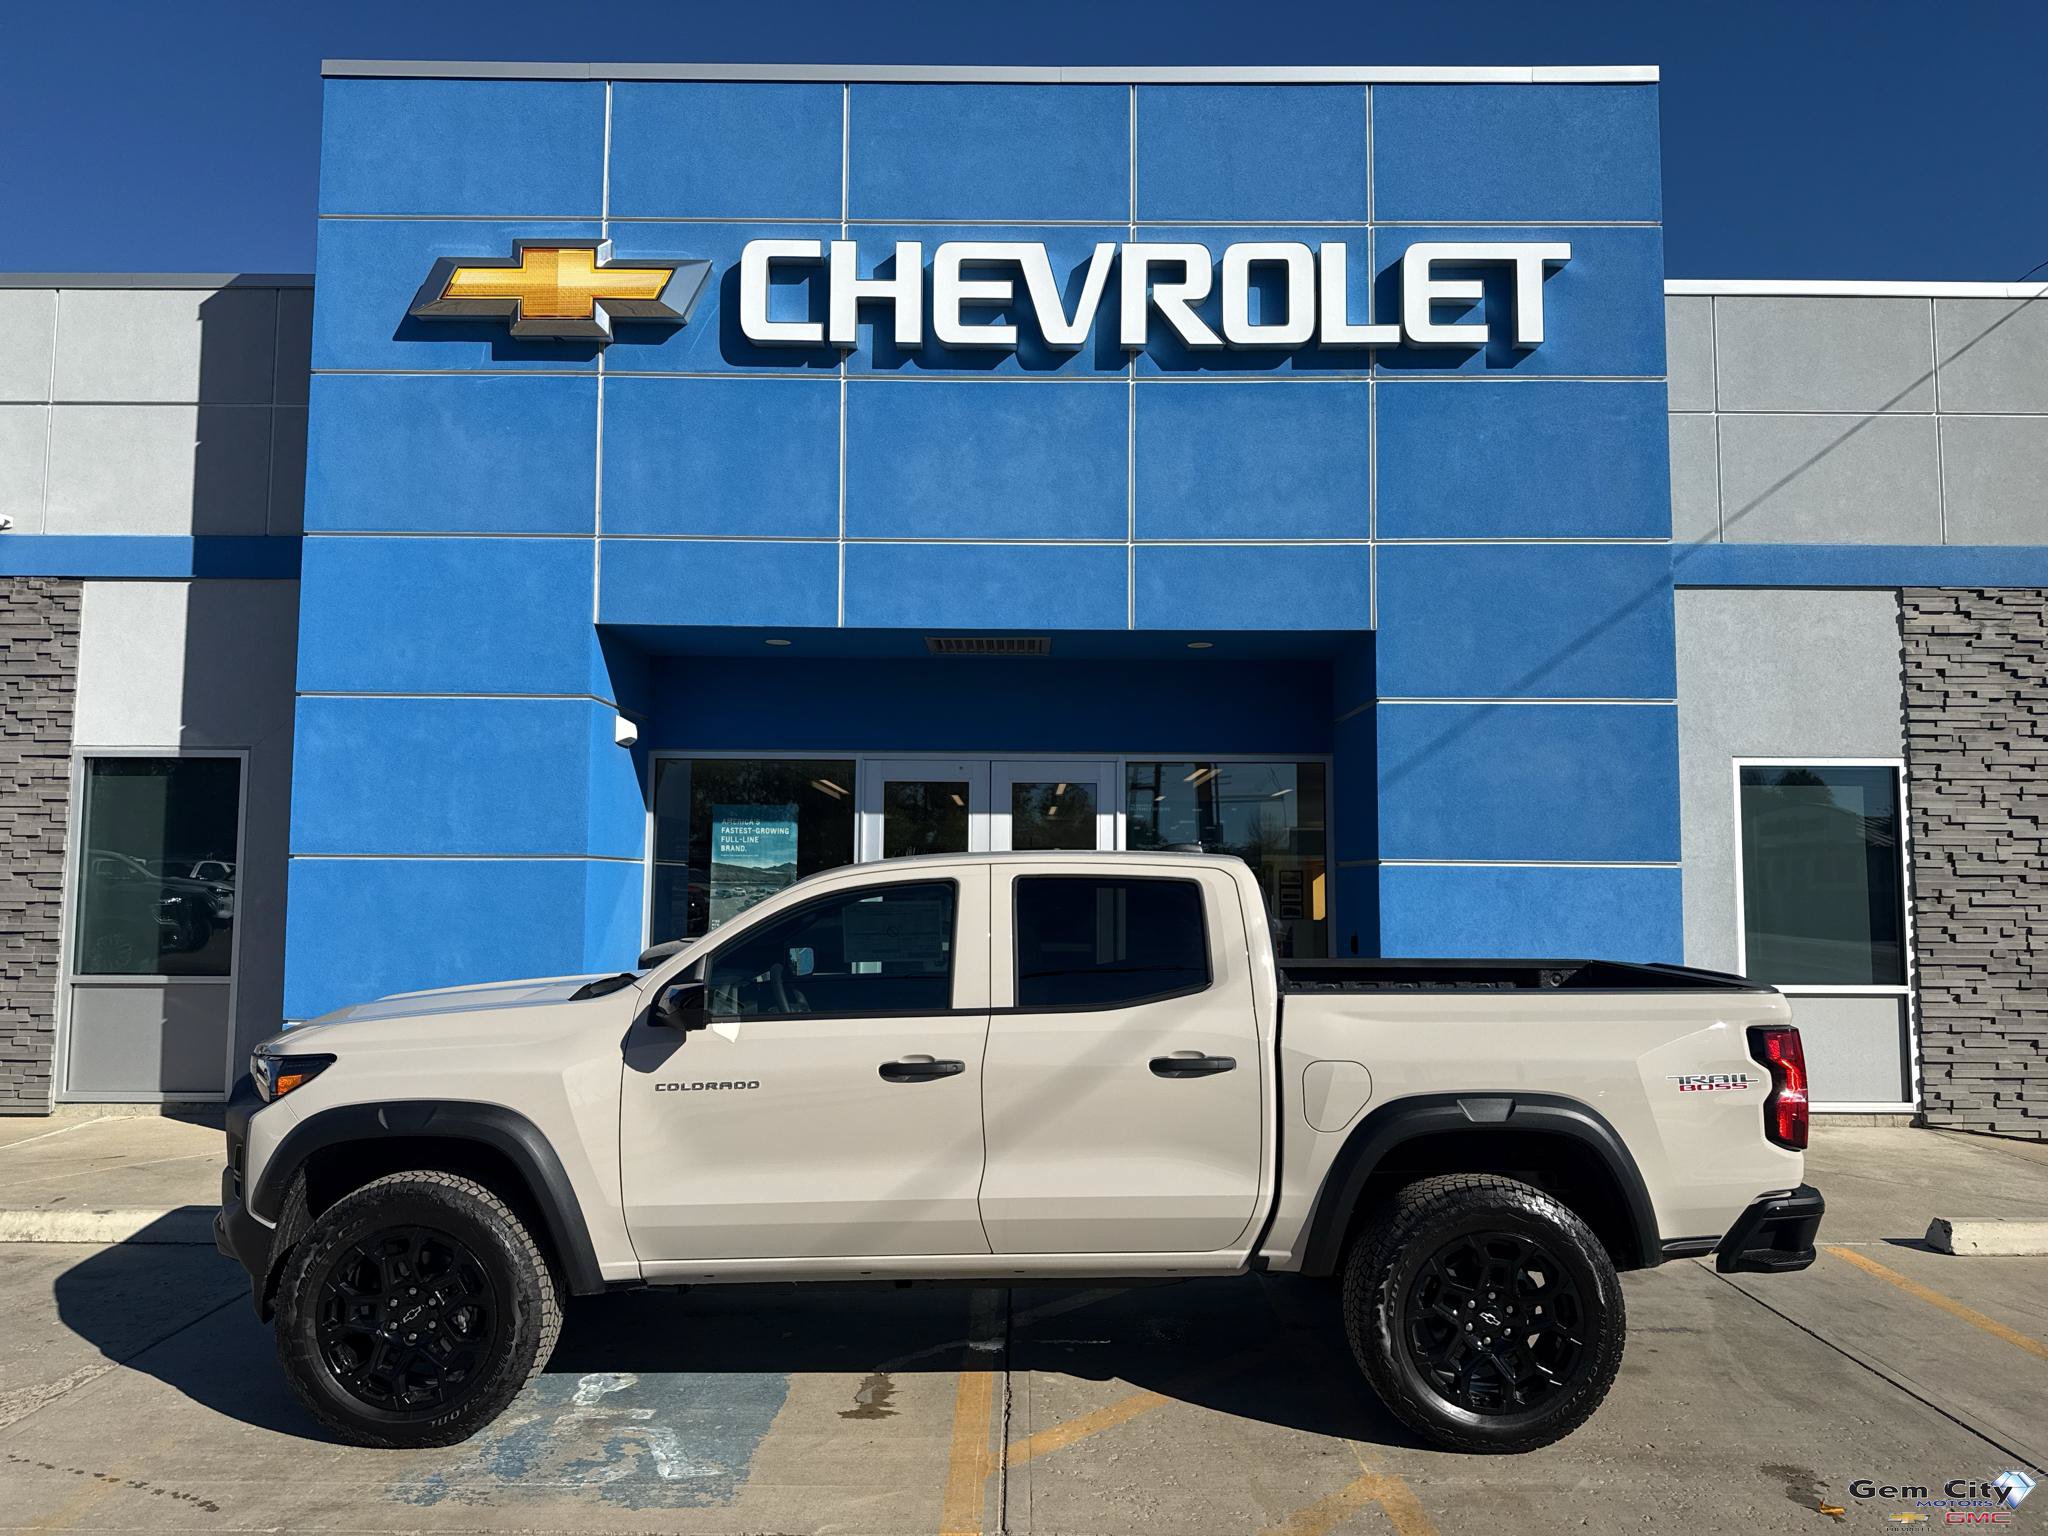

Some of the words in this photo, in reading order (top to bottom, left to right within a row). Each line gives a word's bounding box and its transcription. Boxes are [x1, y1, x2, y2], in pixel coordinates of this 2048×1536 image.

[740, 239, 1573, 349] CHEVROLET
[721, 827, 790, 835] FASTEST-GROWING
[1667, 1073, 1759, 1085] TRAIL
[655, 1081, 760, 1092] COLORADO
[1679, 1083, 1748, 1092] BOSS
